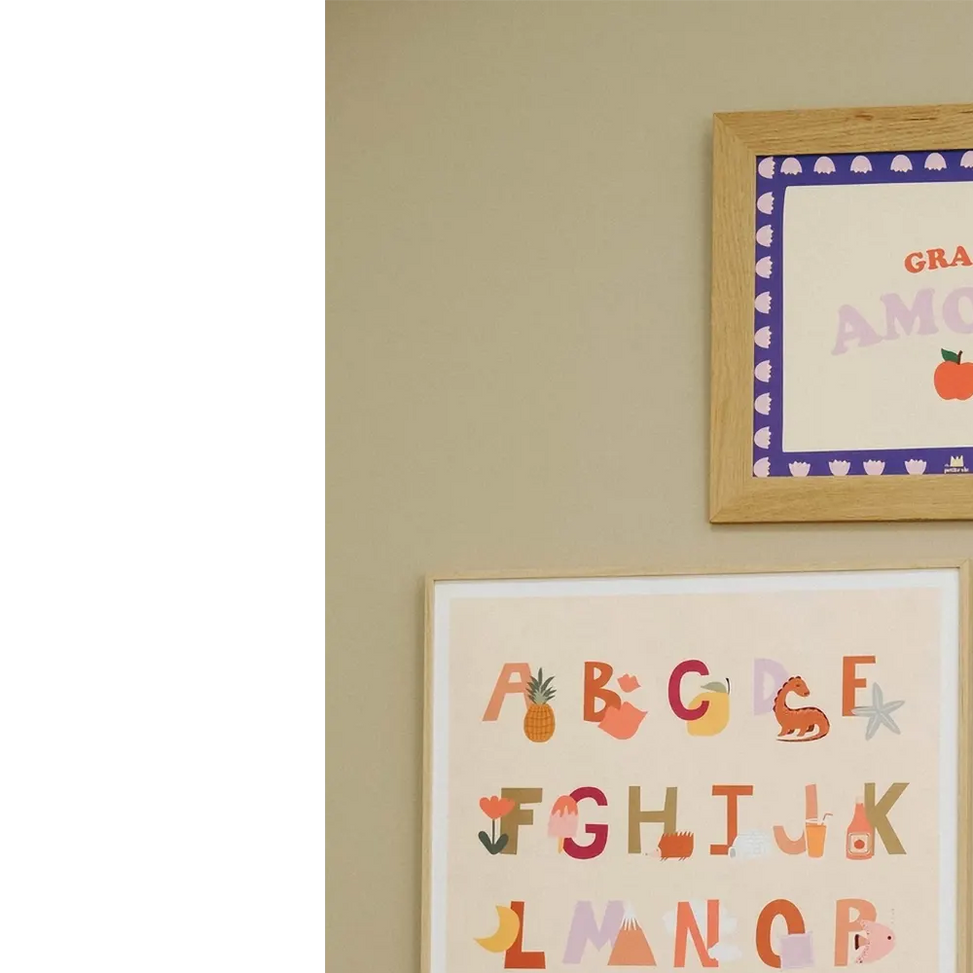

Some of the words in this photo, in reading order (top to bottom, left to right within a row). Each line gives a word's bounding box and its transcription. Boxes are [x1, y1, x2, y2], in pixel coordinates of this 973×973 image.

[482, 662, 534, 722] A
[583, 661, 622, 722] B
[668, 659, 710, 721] C
[753, 658, 790, 717] D
[842, 655, 877, 717] E
[500, 787, 543, 855] F
[563, 786, 609, 860] G
[627, 785, 678, 854] H
[710, 784, 754, 855] I
[773, 784, 818, 855] J
[864, 782, 910, 855] K
[504, 901, 546, 969] L
[562, 900, 626, 965] M
[673, 899, 720, 967] N
[834, 899, 878, 967] P
